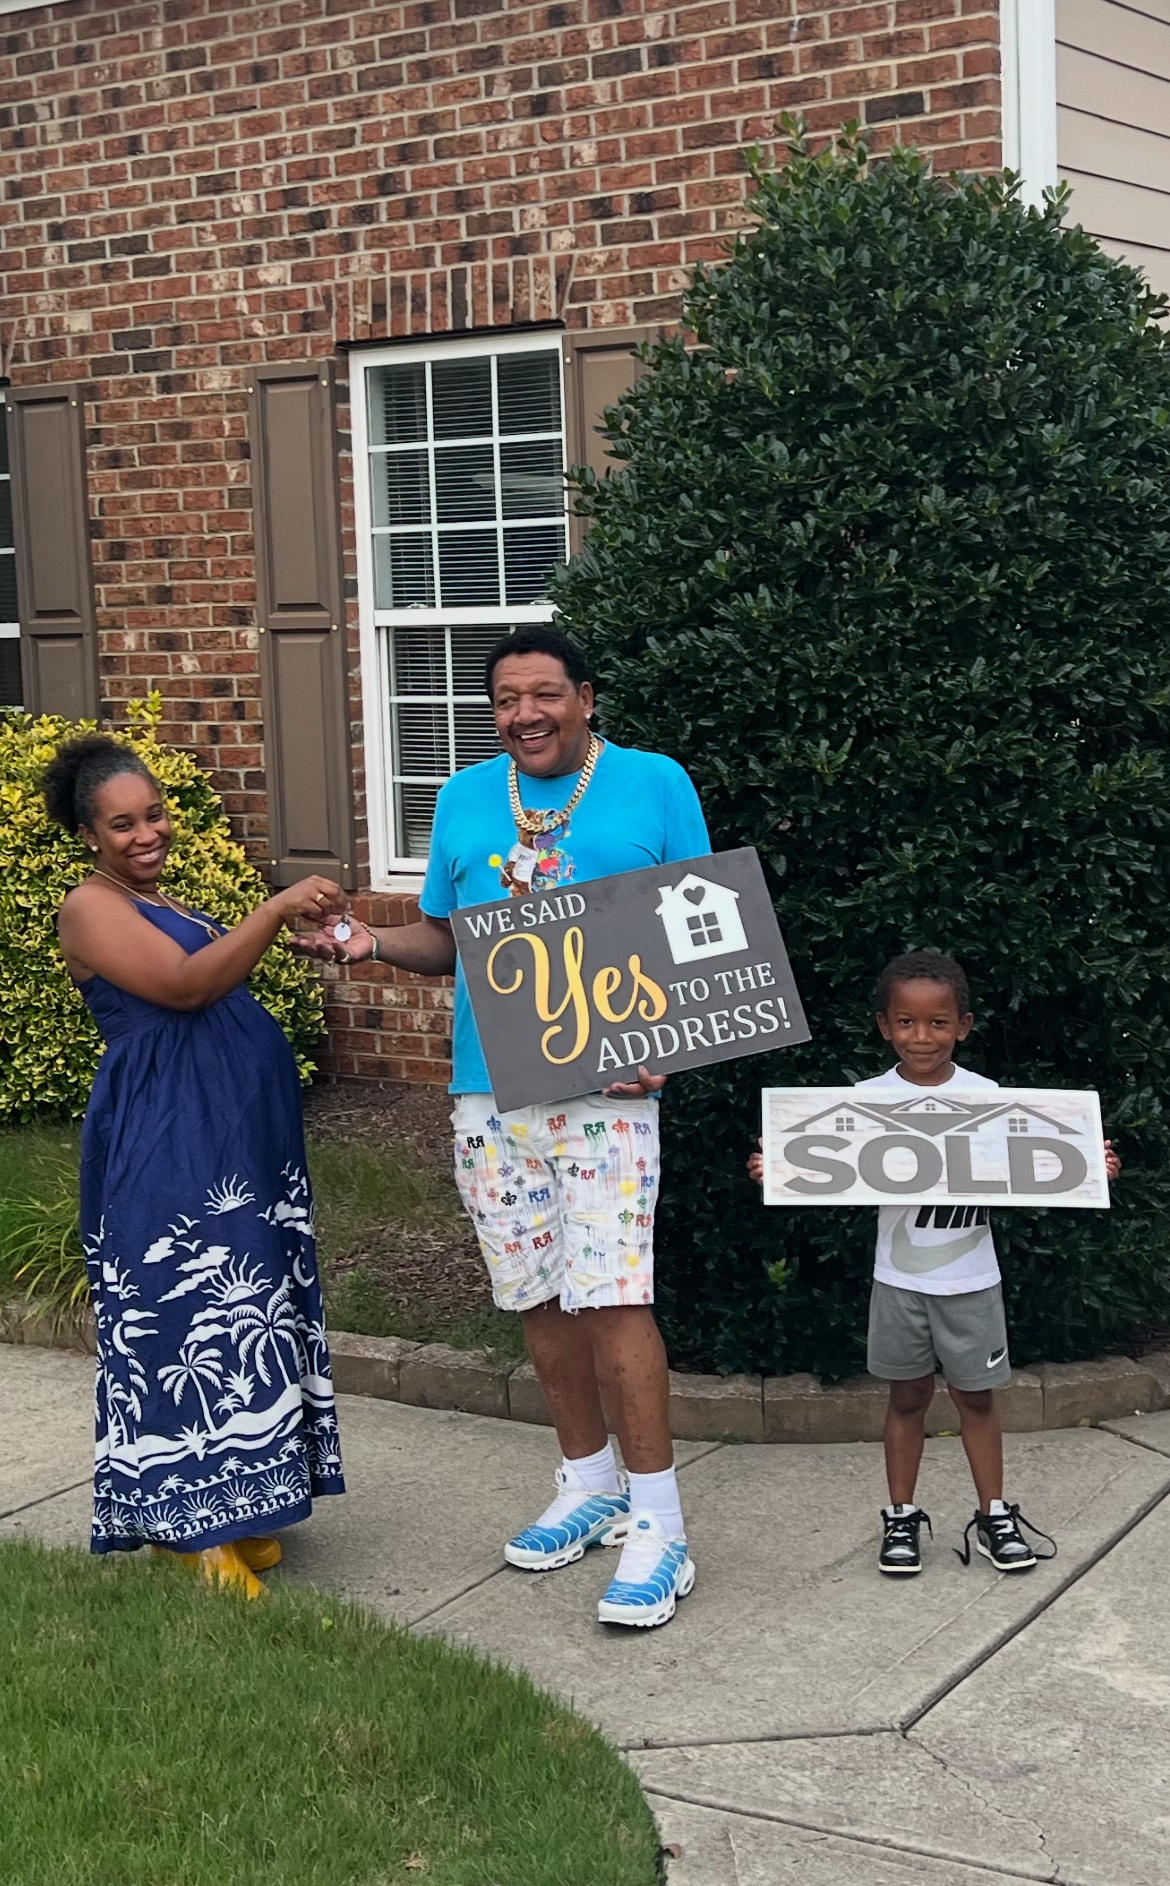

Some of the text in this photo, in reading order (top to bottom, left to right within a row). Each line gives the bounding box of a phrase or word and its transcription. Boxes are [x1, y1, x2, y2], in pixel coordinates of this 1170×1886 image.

[464, 893, 587, 939] WE SAID
[487, 926, 776, 1065] Yes TO THE
[596, 997, 792, 1074] ADDRESS!
[783, 1134, 1088, 1195] SOLD
